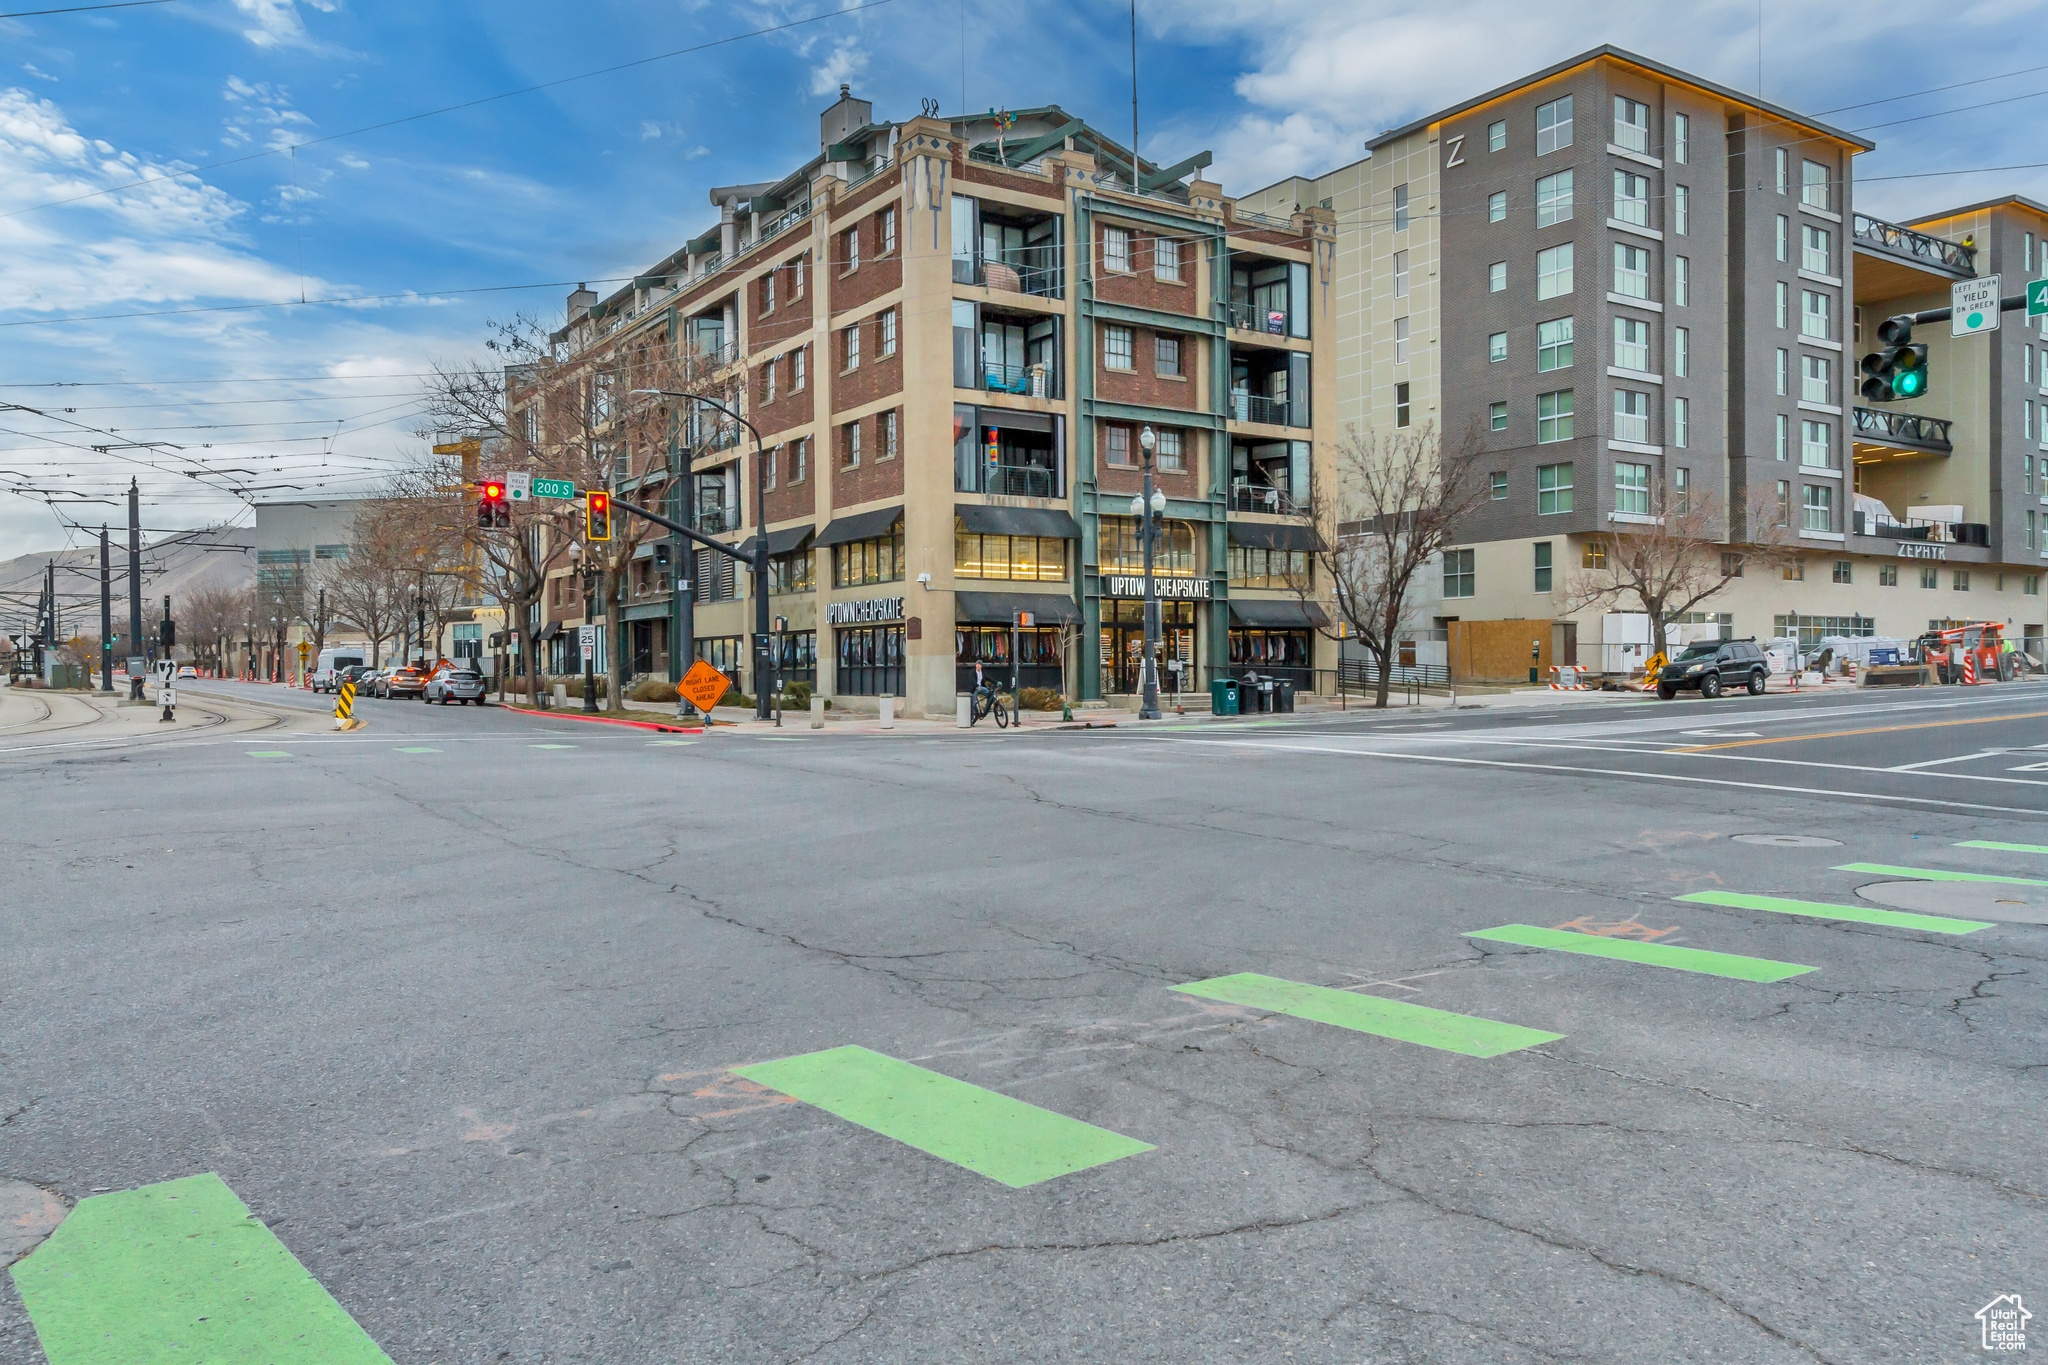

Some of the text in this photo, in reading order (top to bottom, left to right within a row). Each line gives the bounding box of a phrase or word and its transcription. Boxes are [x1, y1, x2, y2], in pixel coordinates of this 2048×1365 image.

[1446, 133, 1465, 169] Z
[1954, 279, 1997, 294] LEFT TURN
[1963, 290, 1988, 302] YIELD
[1956, 300, 1994, 314] ON GREEN
[537, 482, 570, 496] 200 S
[1897, 543, 1946, 560] ZEPHYR
[1111, 577, 1209, 598] UPTOW CHEAPSKATE
[825, 597, 902, 624] UPTOWN CHEAPSKATE
[581, 635, 594, 644] 25
[686, 675, 720, 686] RIGHT LANE
[692, 684, 715, 694] CLOSED
[696, 693, 715, 701] AHEAD
